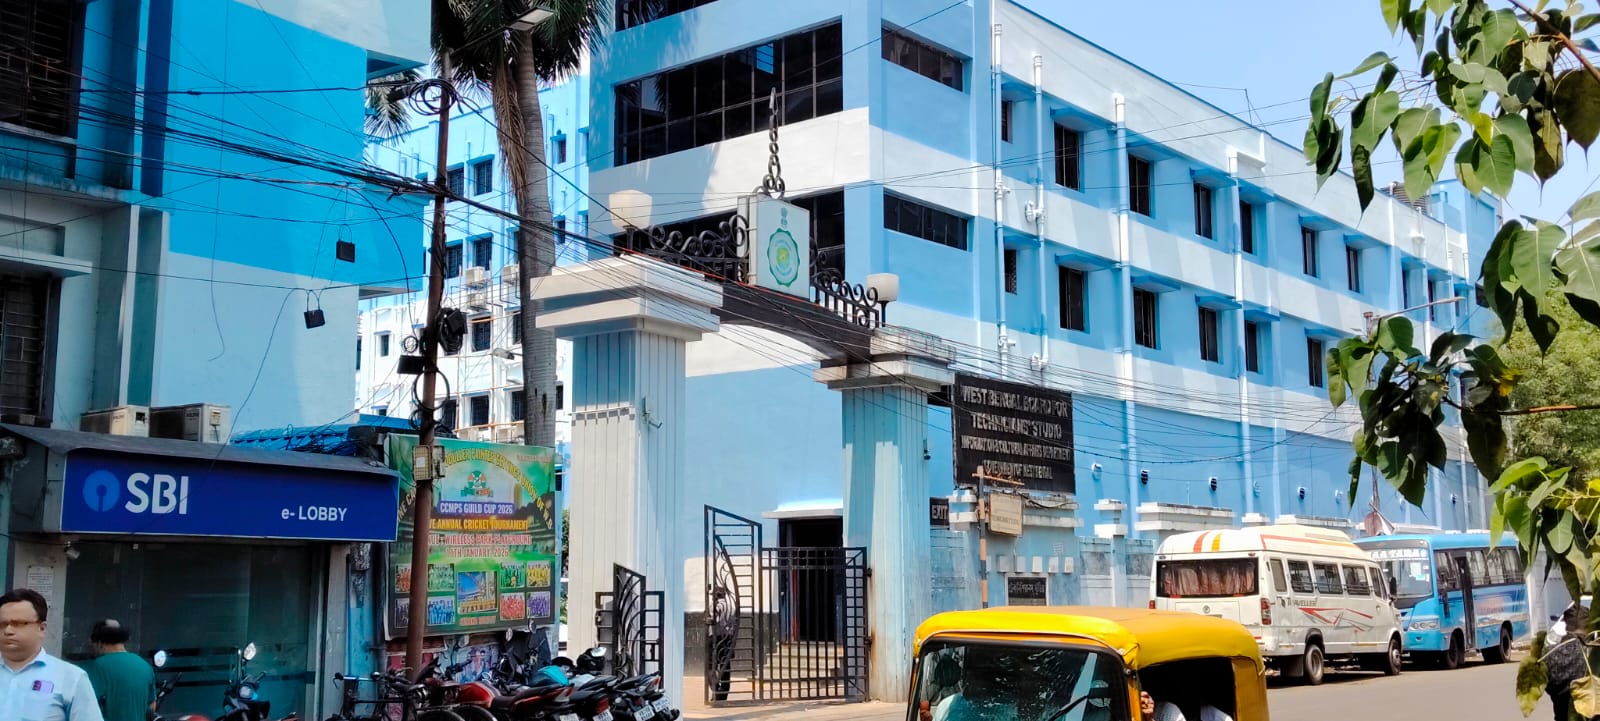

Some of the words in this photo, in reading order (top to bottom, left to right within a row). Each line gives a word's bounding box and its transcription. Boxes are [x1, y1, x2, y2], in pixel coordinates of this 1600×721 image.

[960, 385, 988, 405] WEST
[988, 390, 1022, 411] BENGAL
[1023, 395, 1051, 415] BOARD
[1052, 399, 1069, 418] FOR
[1032, 421, 1062, 440] STUDIO
[125, 472, 190, 515] SBI
[298, 505, 348, 523] LOBBY
[440, 502, 463, 513] CCMPS
[464, 503, 482, 513] GUILD
[484, 504, 496, 514] CUP
[498, 504, 513, 514] 2026
[931, 504, 948, 519] EXIT
[437, 519, 462, 529] ANNUAL
[463, 519, 490, 530] CRICKET
[491, 519, 528, 530] TOURNAMENT
[445, 534, 475, 545] WIRELESS
[463, 547, 490, 558] JANUARY
